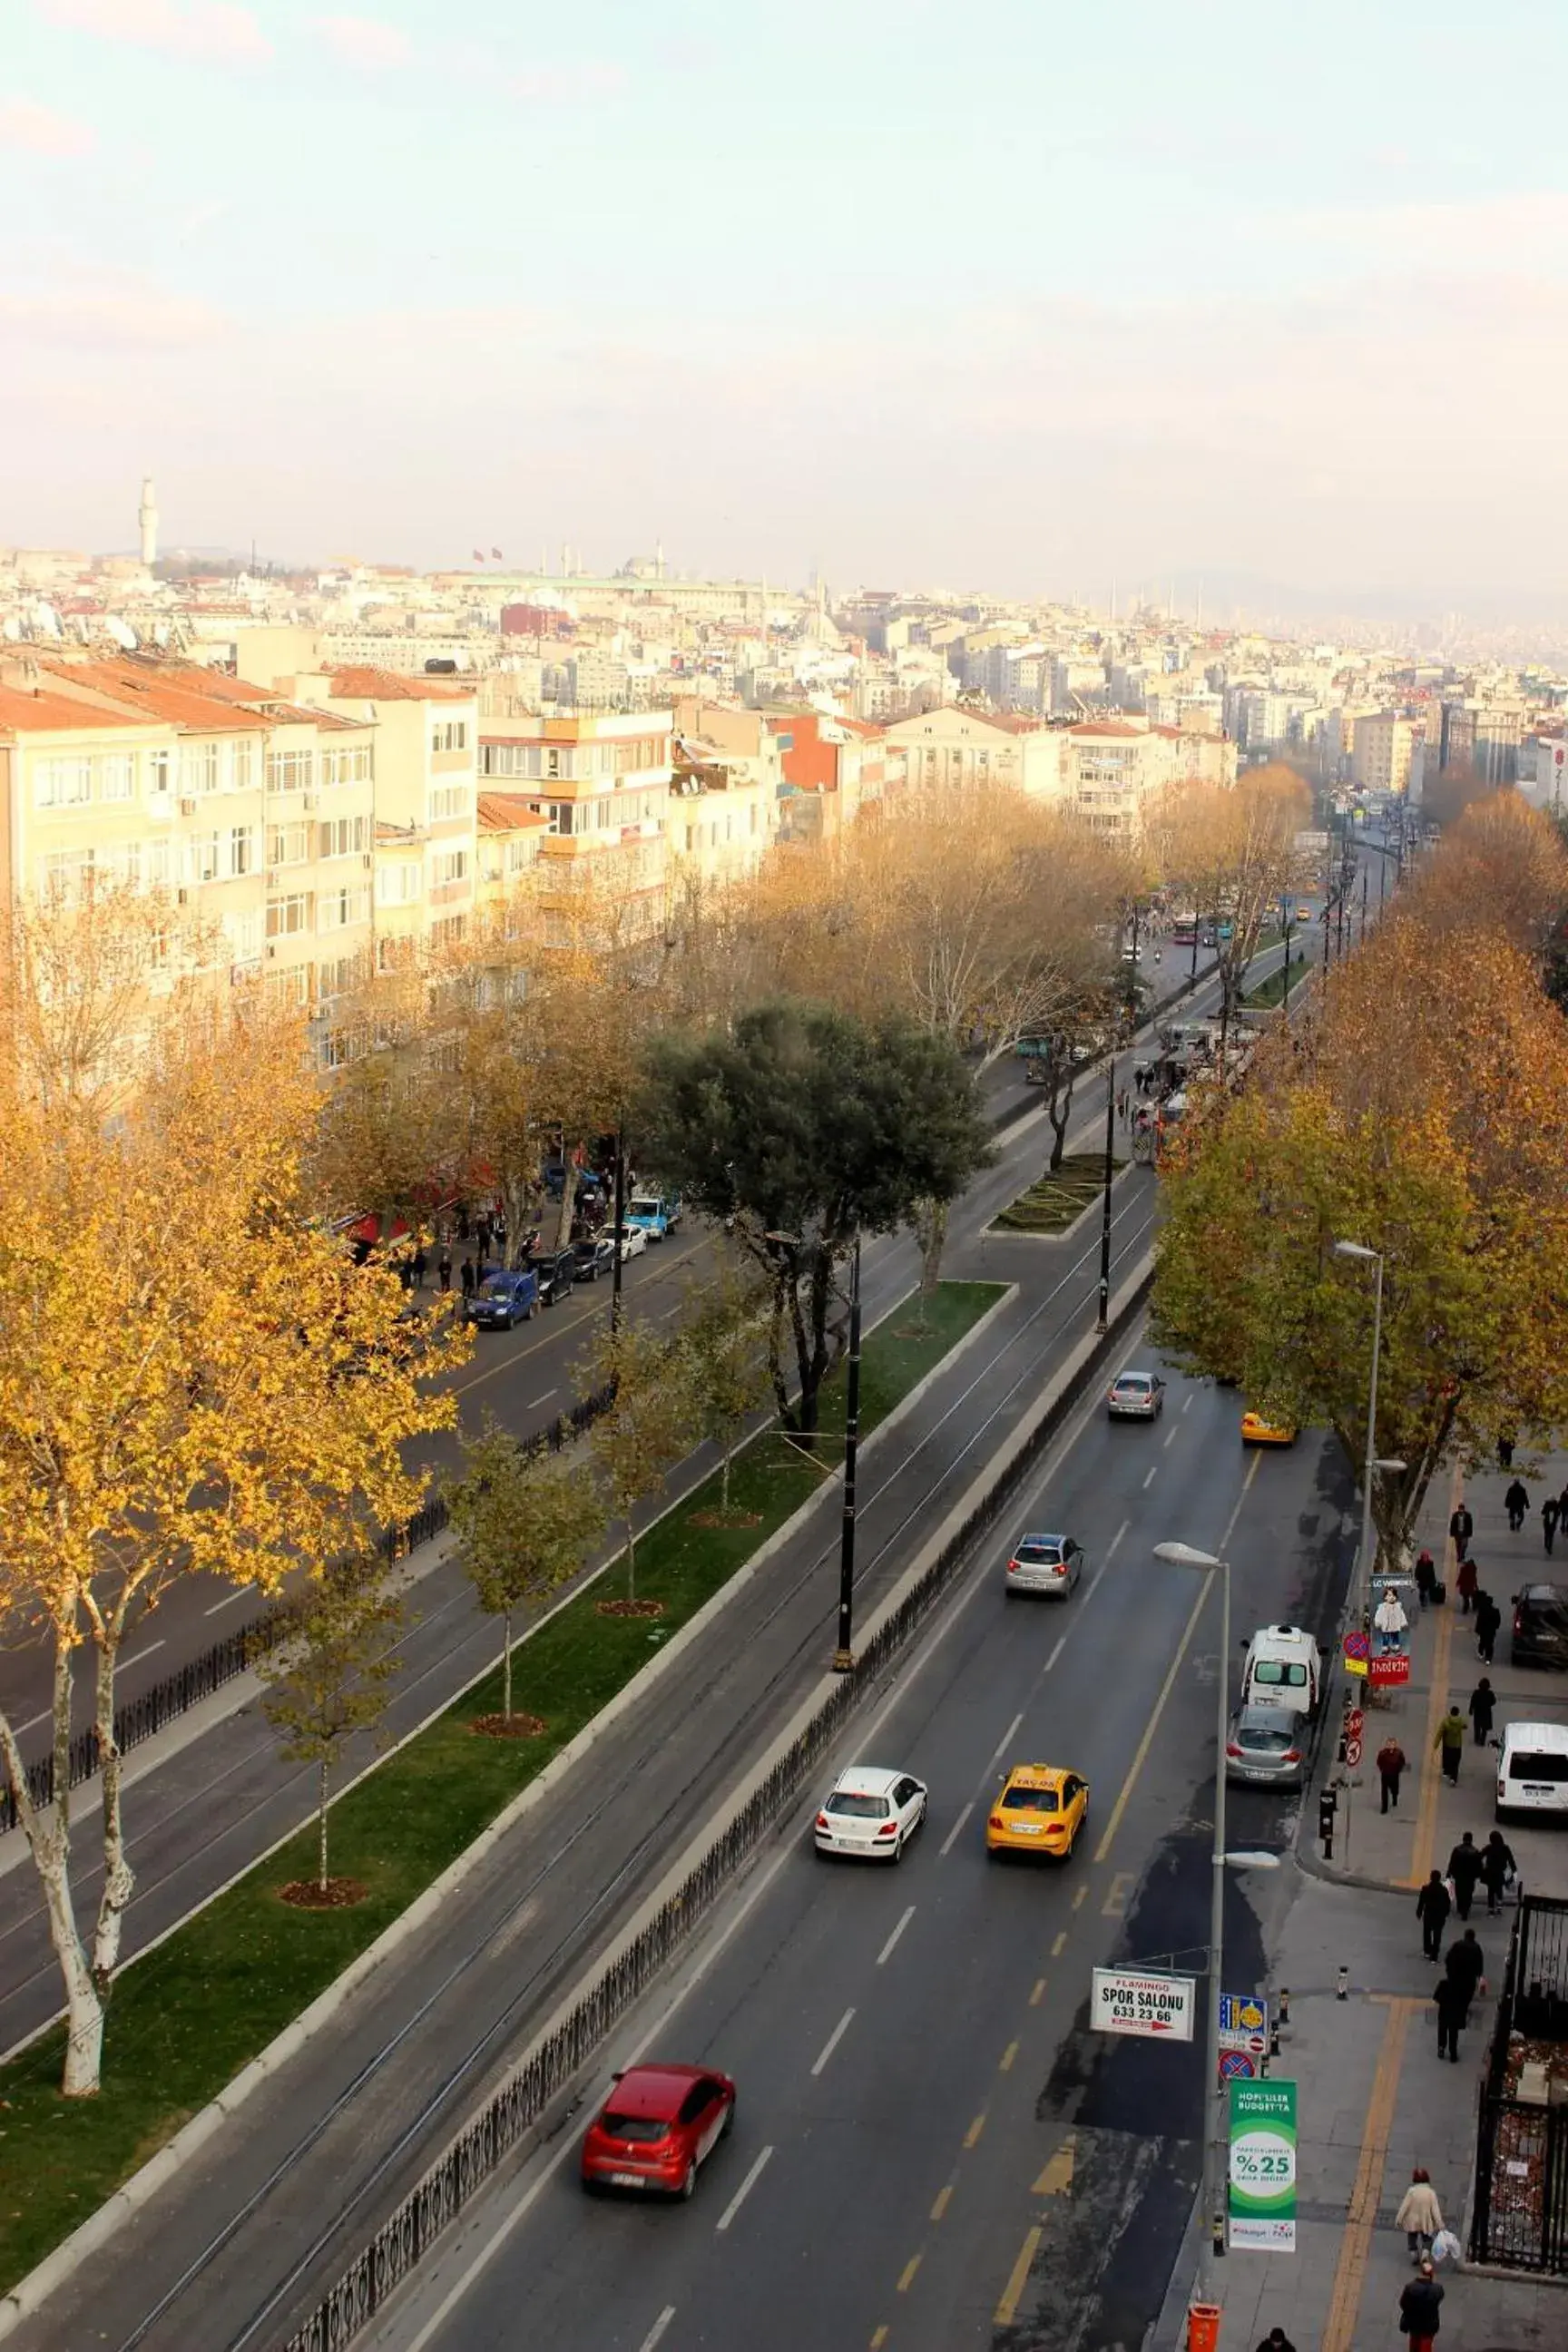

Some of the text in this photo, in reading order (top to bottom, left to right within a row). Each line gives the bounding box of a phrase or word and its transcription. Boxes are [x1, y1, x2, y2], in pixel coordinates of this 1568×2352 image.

[1102, 1987, 1183, 2011] SPOR SALONU
[1113, 2005, 1171, 2022] 633 23 66
[1236, 2155, 1289, 2174] %25
